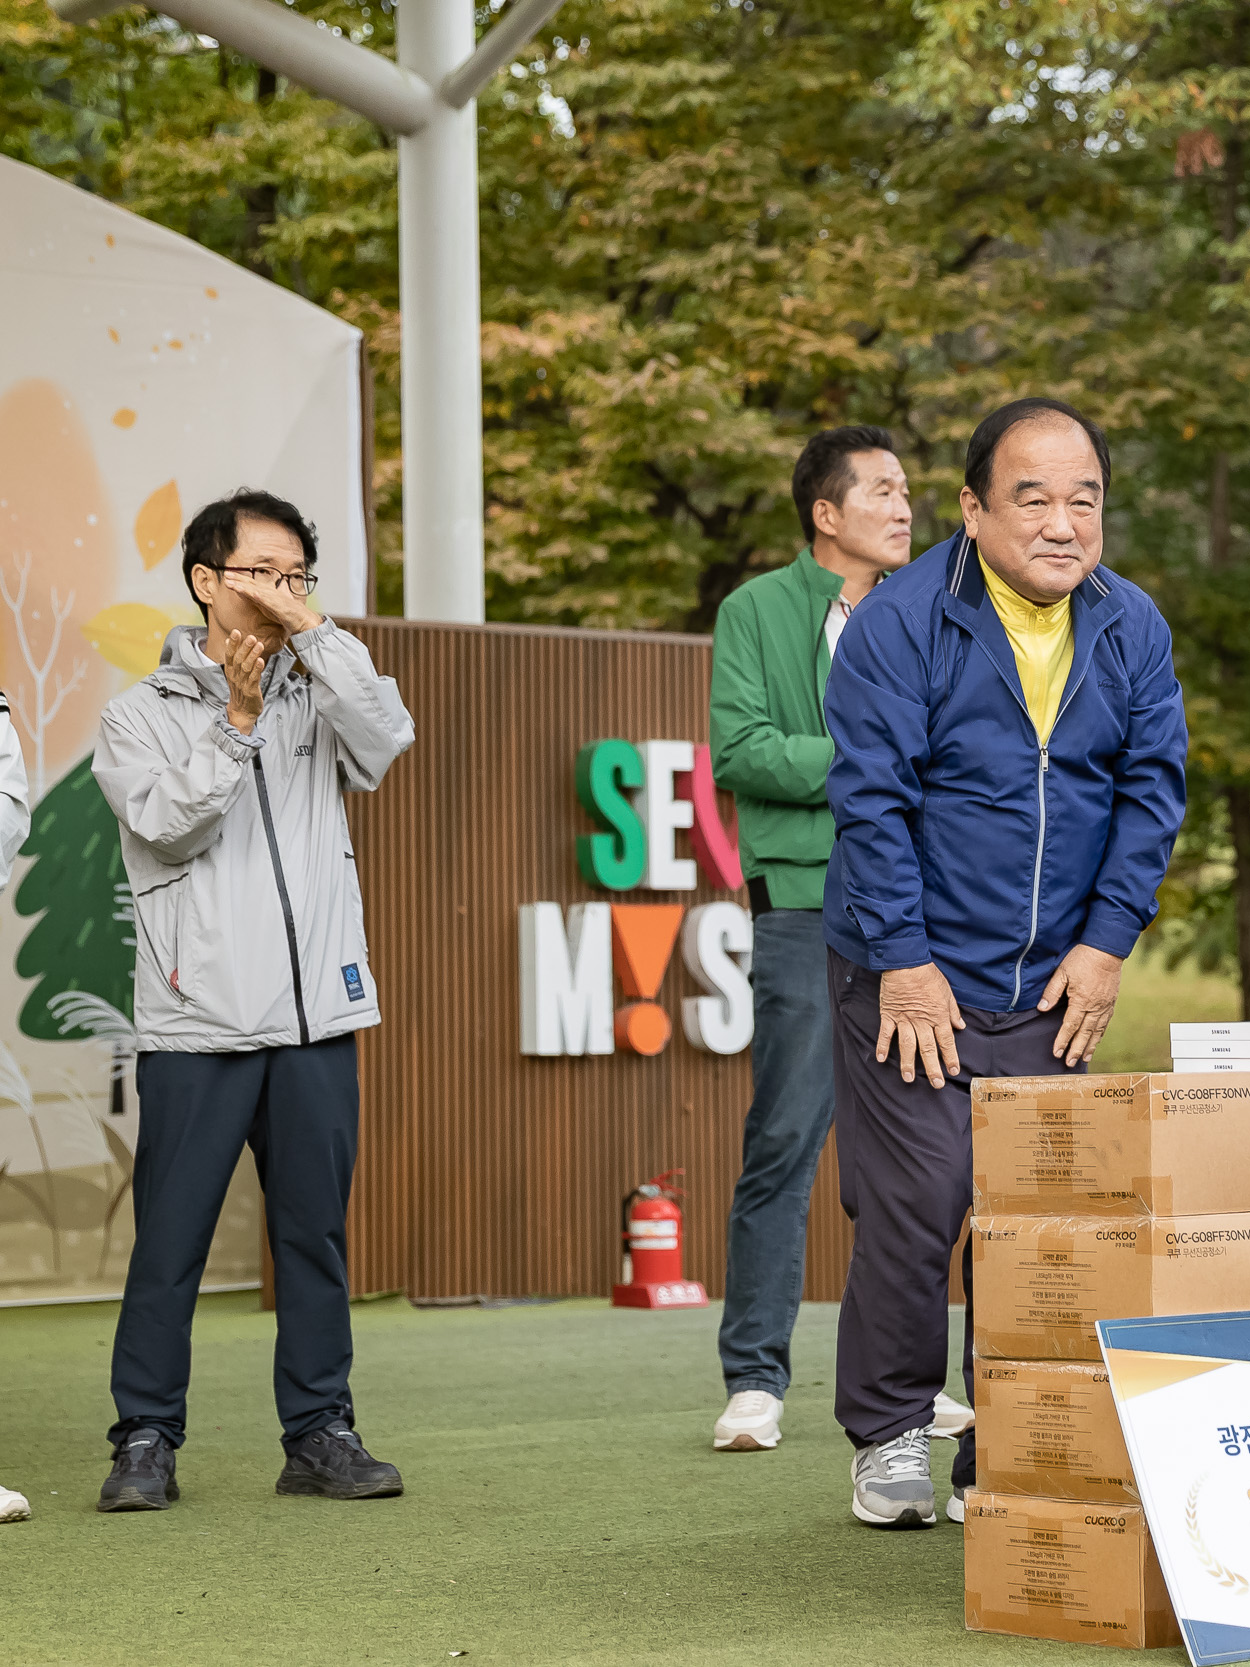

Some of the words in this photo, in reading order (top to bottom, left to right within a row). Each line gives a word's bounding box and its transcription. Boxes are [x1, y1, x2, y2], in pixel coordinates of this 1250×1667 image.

[1094, 1088, 1134, 1098] CUCKOO
[1163, 1105, 1177, 1115] 쿠쿠
[1179, 1104, 1223, 1115] 무선진공청소기
[1096, 1231, 1137, 1240] CUCKOO
[1167, 1248, 1181, 1259] 쿠쿠
[1183, 1247, 1227, 1258] 무선진공청소기
[1085, 1516, 1126, 1526] CUCKOO
